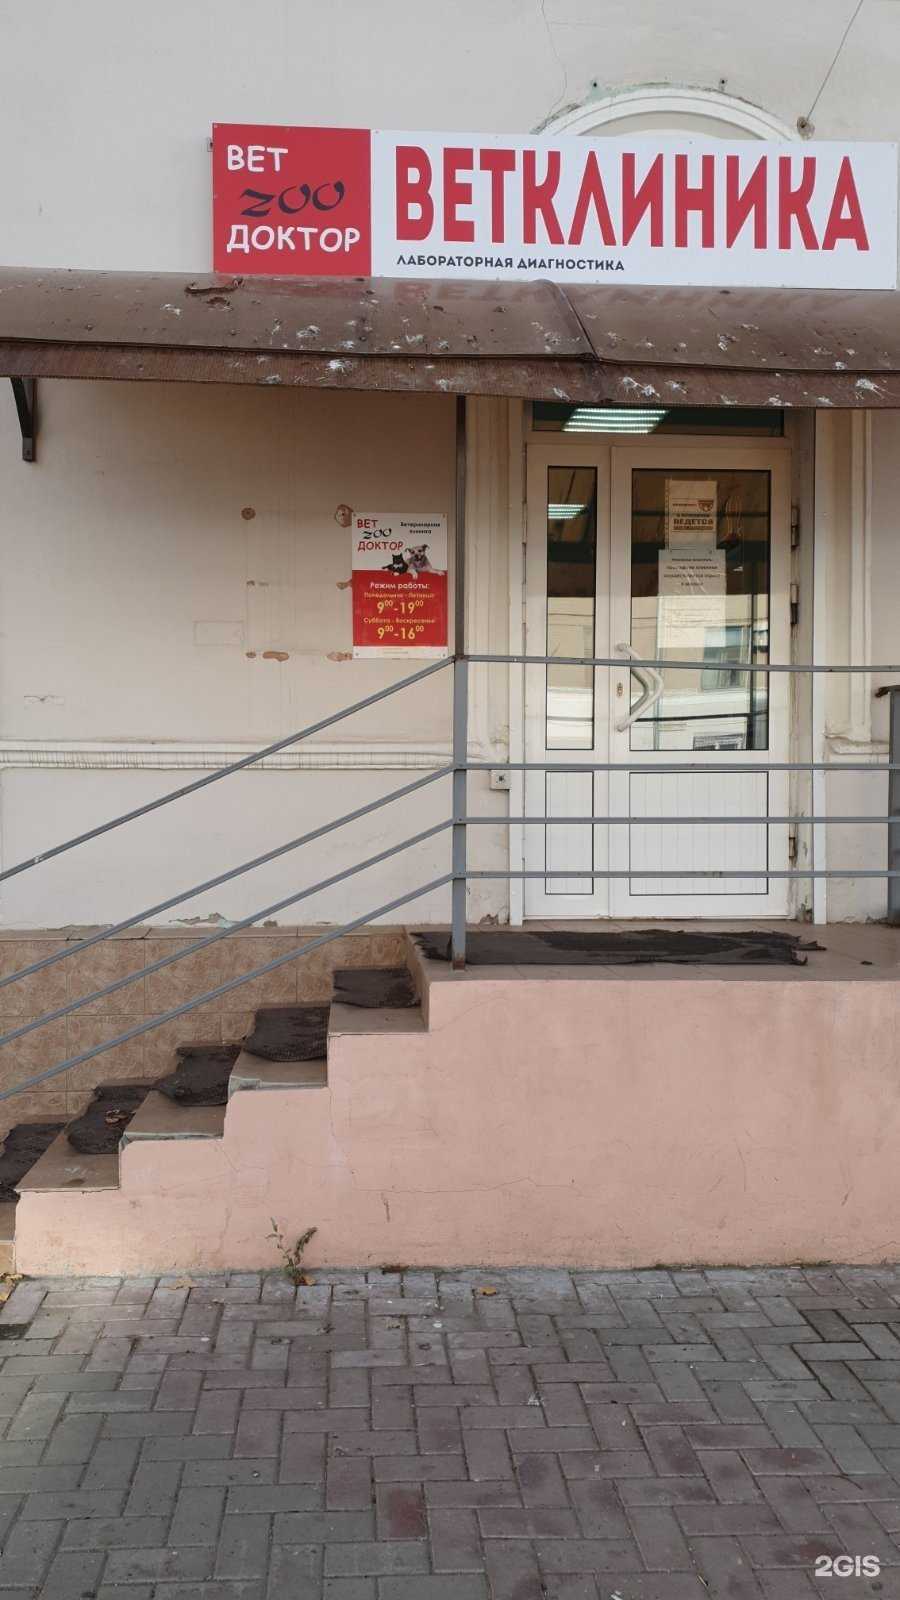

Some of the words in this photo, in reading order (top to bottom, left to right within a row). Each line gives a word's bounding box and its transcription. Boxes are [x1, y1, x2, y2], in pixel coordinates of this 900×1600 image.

[227, 144, 288, 172] ВЕТ
[395, 145, 870, 251] ВЕТКЛИНИКА
[226, 224, 361, 254] ДОКТОР
[396, 255, 513, 268] ЛАБОРАТОРНАЯ
[517, 257, 625, 271] ДИАГНОСТИКА
[357, 518, 379, 529] ВЕТ
[357, 541, 404, 552] ДОКТОР
